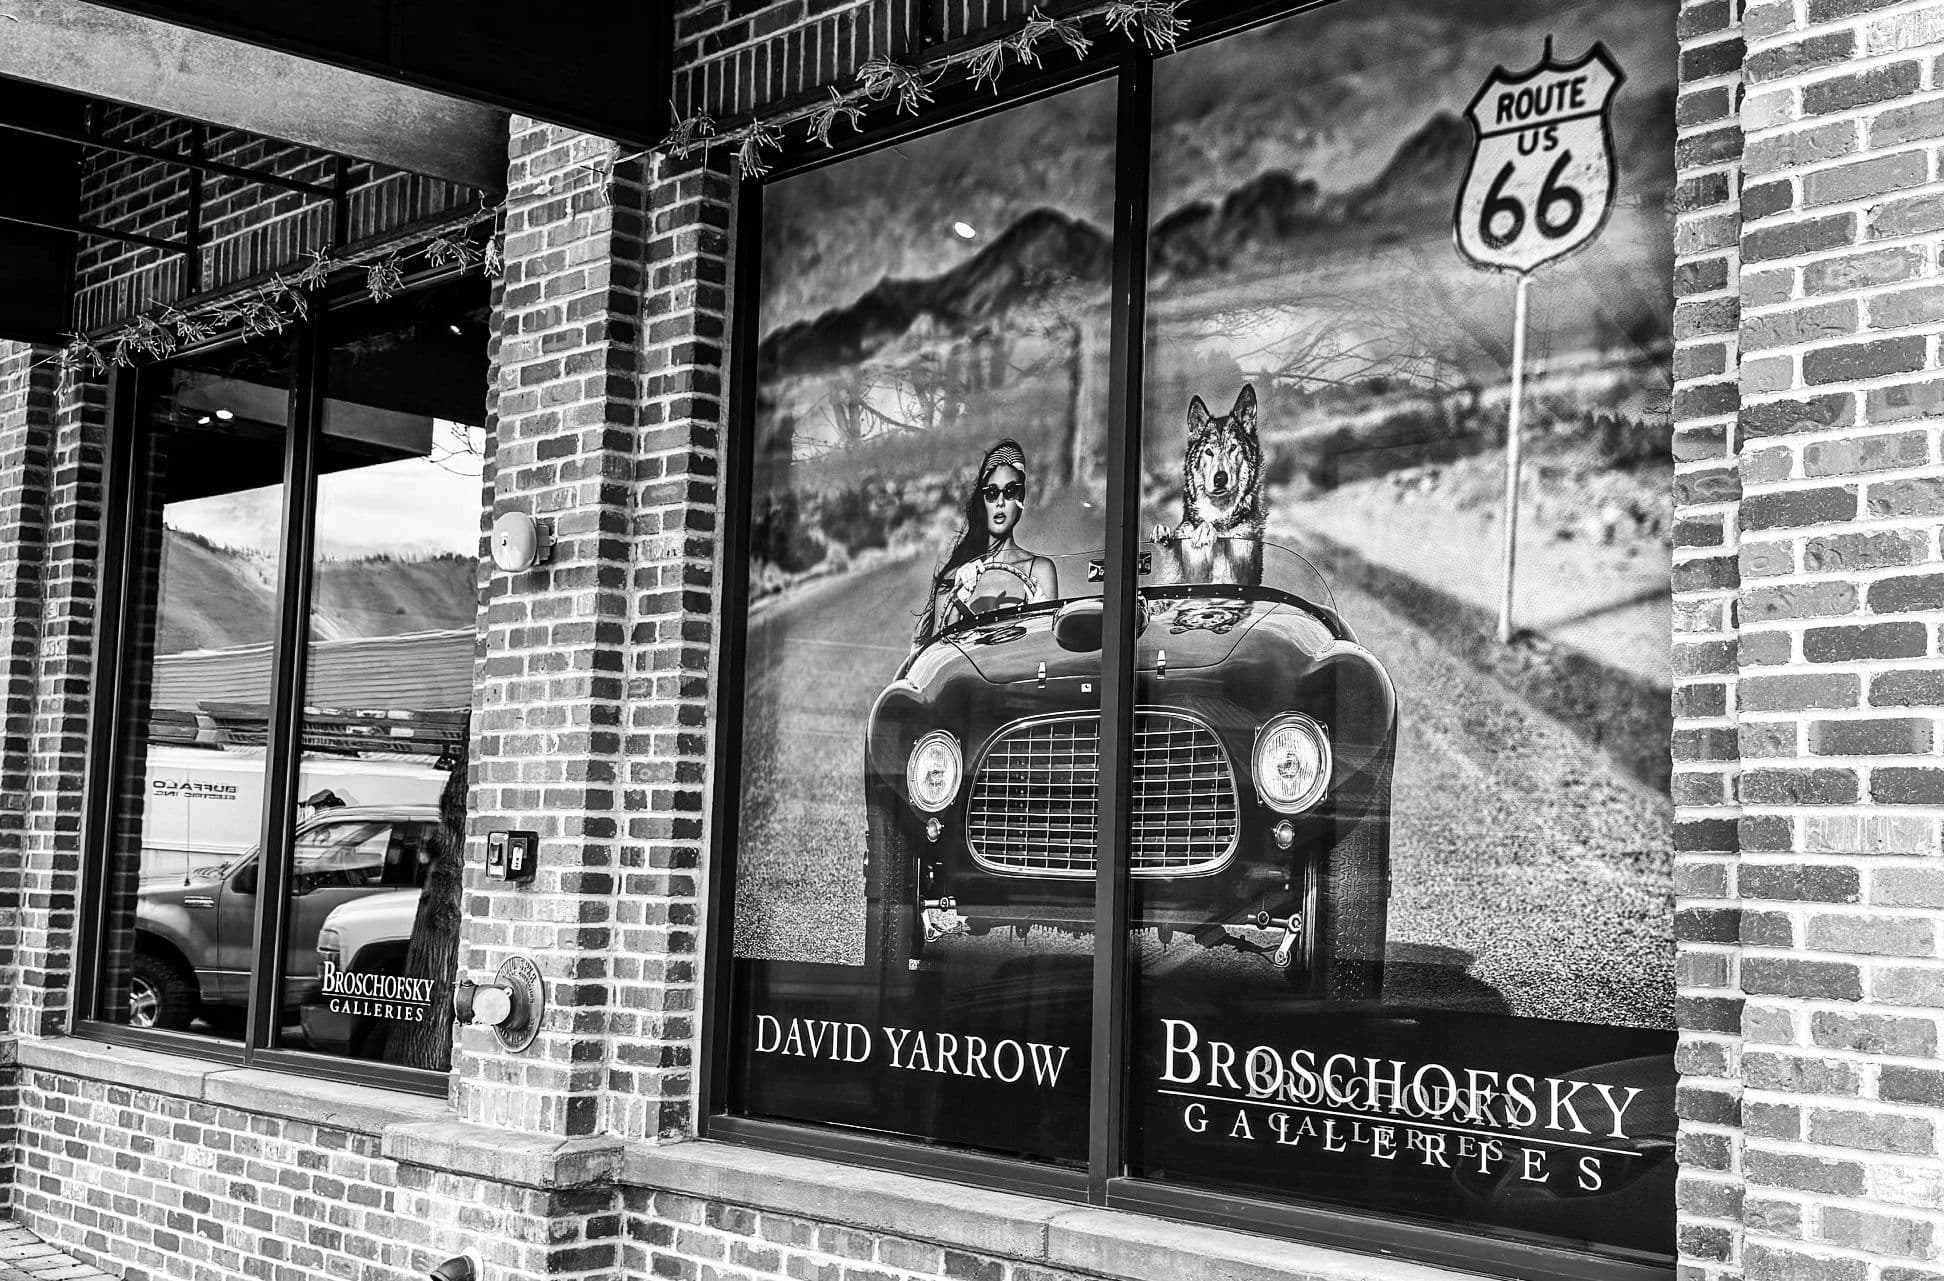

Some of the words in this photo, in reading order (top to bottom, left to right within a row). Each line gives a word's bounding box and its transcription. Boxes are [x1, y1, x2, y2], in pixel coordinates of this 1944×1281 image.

[1496, 75, 1588, 125] ROUTE
[1517, 126, 1560, 156] US
[1478, 149, 1584, 250] 66
[321, 960, 435, 1002] BROSCHOFSKY
[329, 998, 424, 1022] GALLERIES
[755, 1014, 872, 1063] DAVID
[882, 1026, 1071, 1088] YARROW
[1158, 1018, 1644, 1140] BROSCHOFSKY
[1184, 1103, 1603, 1192] GALLERIES
